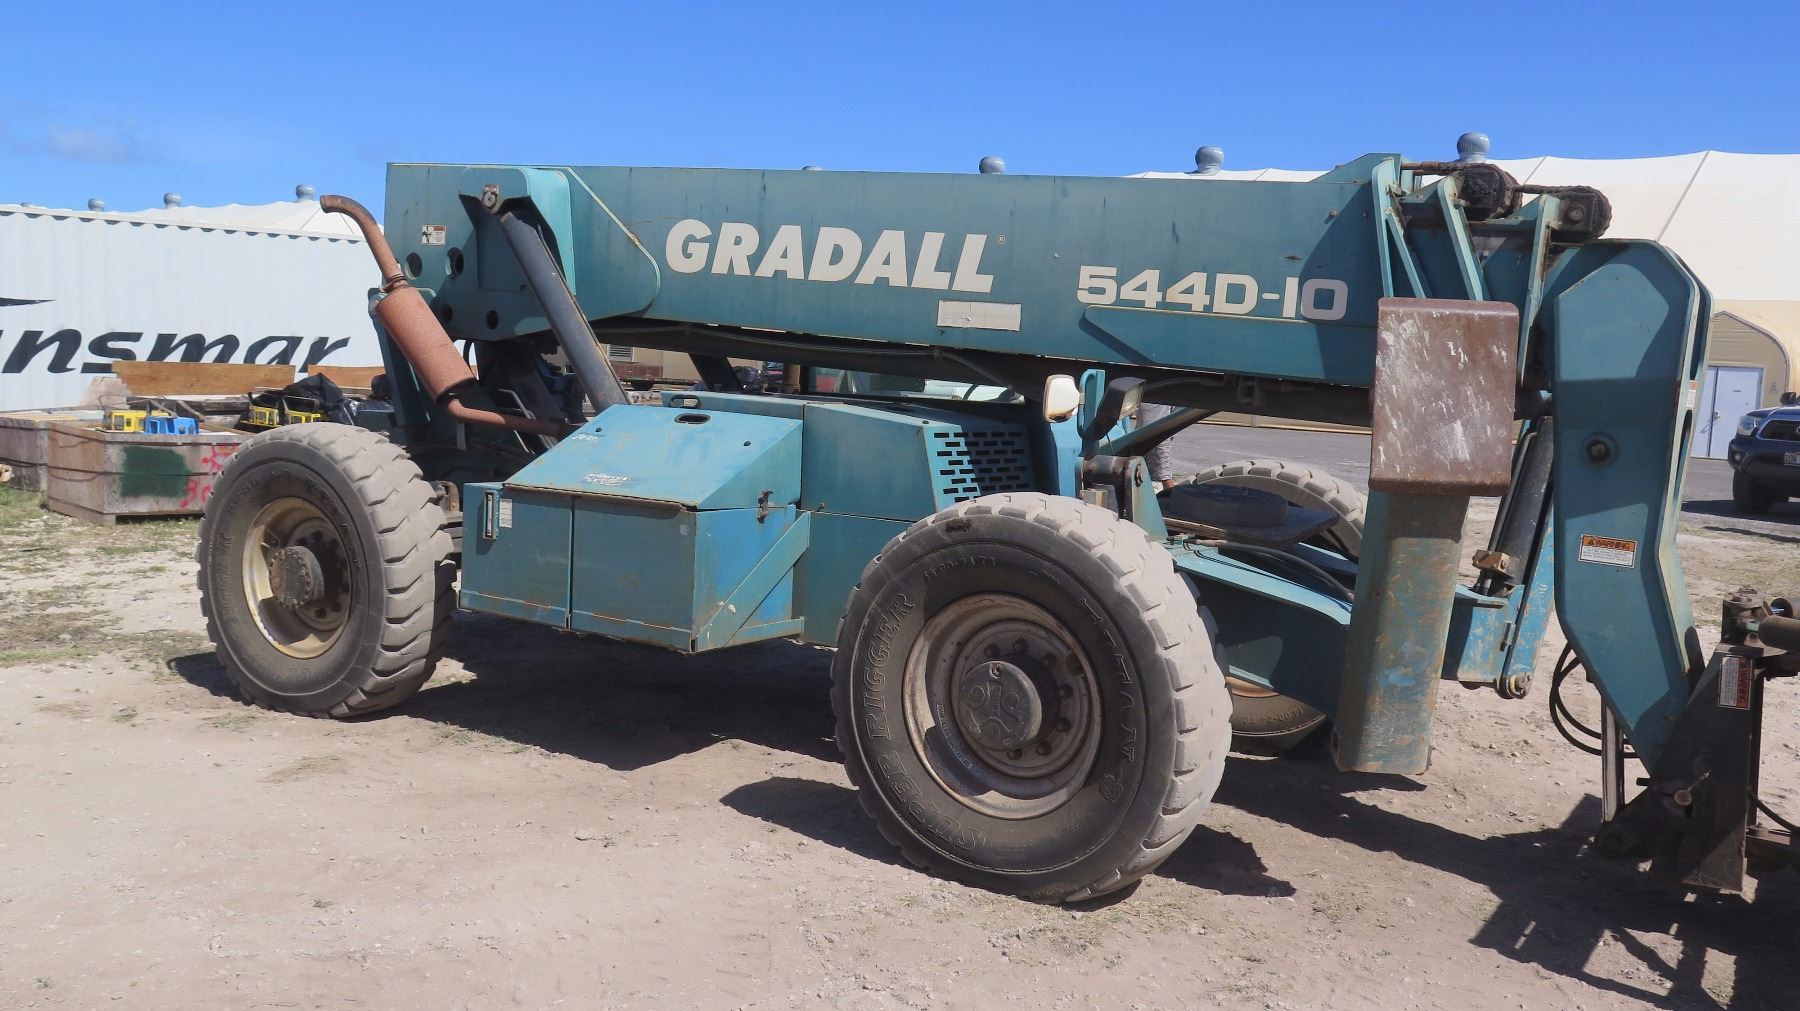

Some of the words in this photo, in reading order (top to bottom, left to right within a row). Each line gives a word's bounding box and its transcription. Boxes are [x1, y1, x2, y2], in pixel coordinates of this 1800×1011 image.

[665, 219, 994, 293] GRADALL
[1077, 265, 1348, 321] 544D-10
[0, 328, 350, 374] nsmar
[1595, 539, 1630, 550] WARNING
[864, 592, 916, 743] RIGGER
